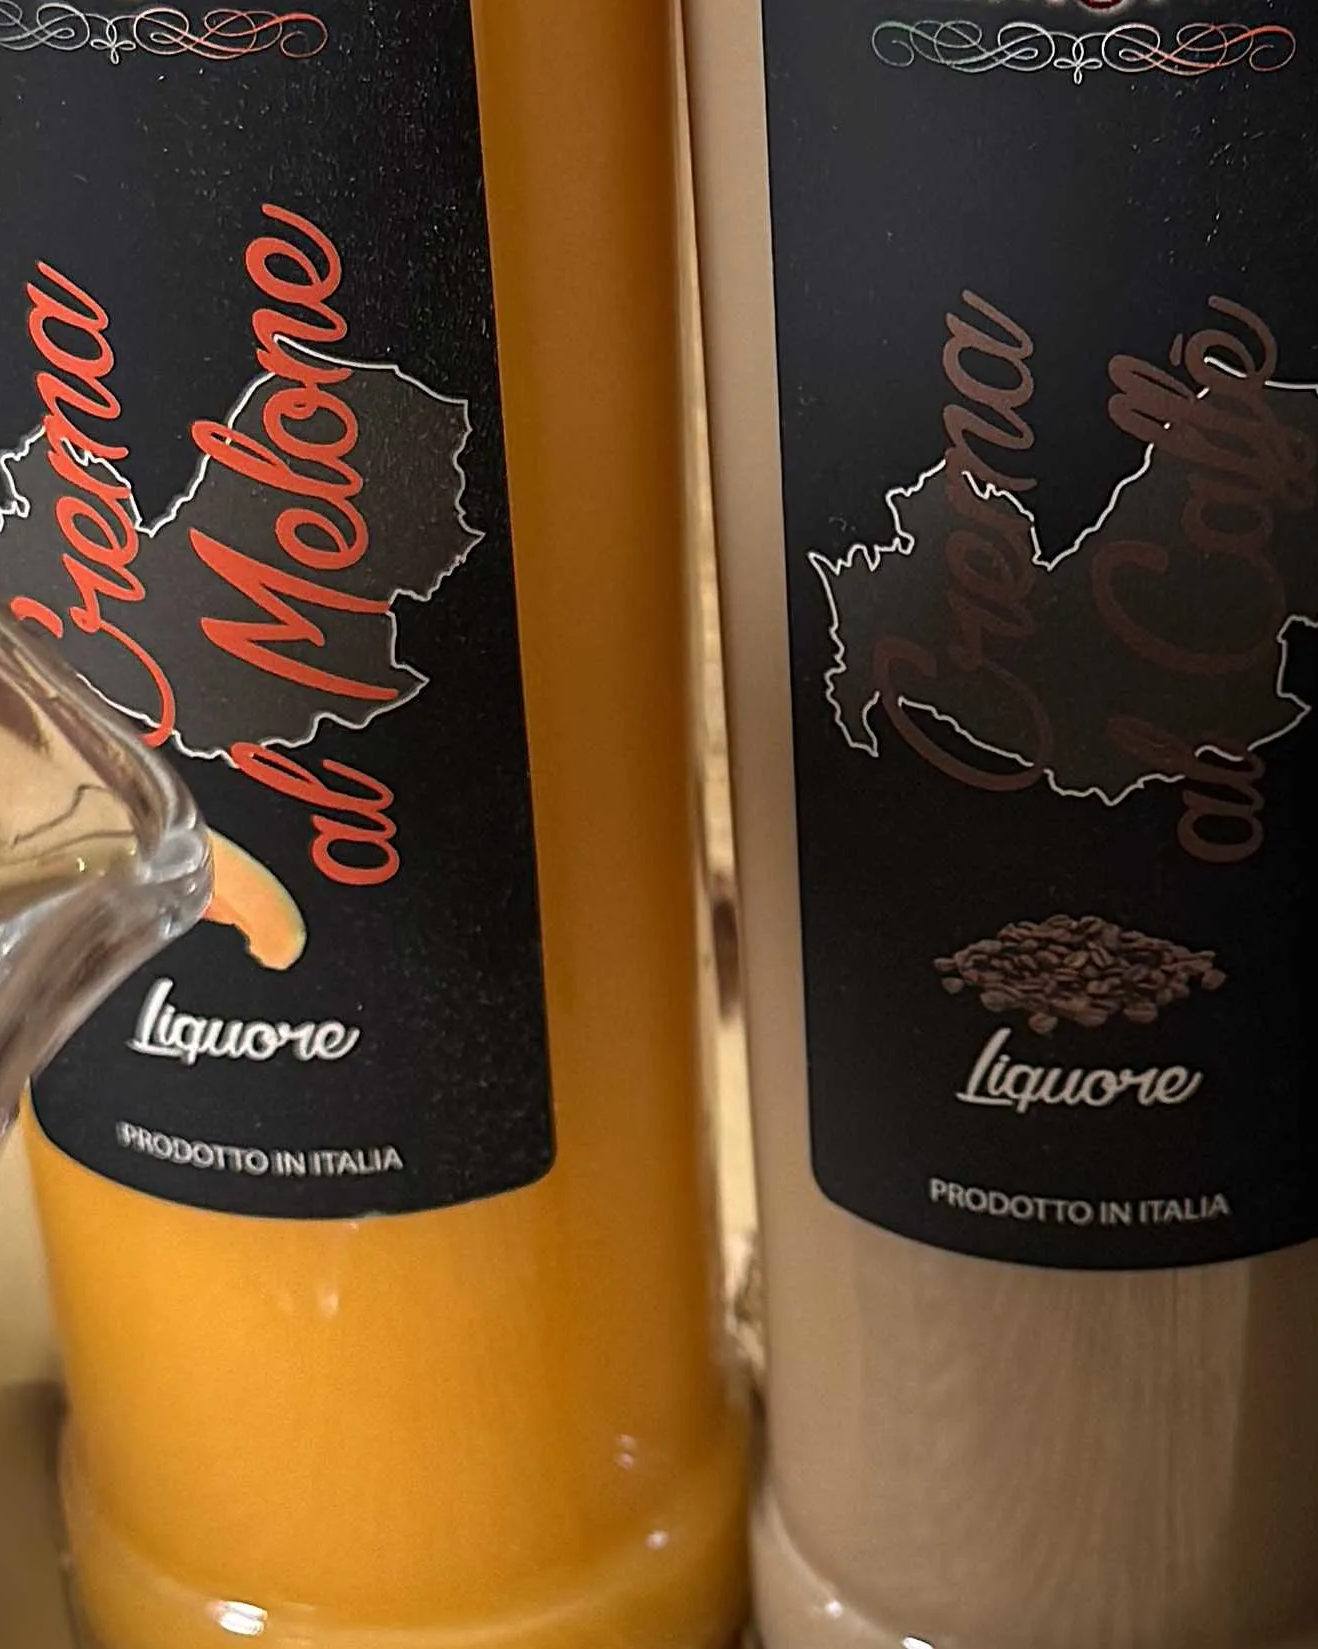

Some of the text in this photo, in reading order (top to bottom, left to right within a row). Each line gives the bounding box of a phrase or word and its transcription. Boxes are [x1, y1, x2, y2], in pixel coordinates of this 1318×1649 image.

[189, 203, 401, 885] al Melone
[876, 289, 1055, 792] Crema
[1105, 715, 1265, 862] al
[126, 978, 360, 1064] Liquore
[956, 1028, 1204, 1113] Liquore
[117, 1121, 404, 1176] PRODOTTO IN ITALIA
[929, 1178, 1231, 1225] PRODOTTO IN ITALIA
